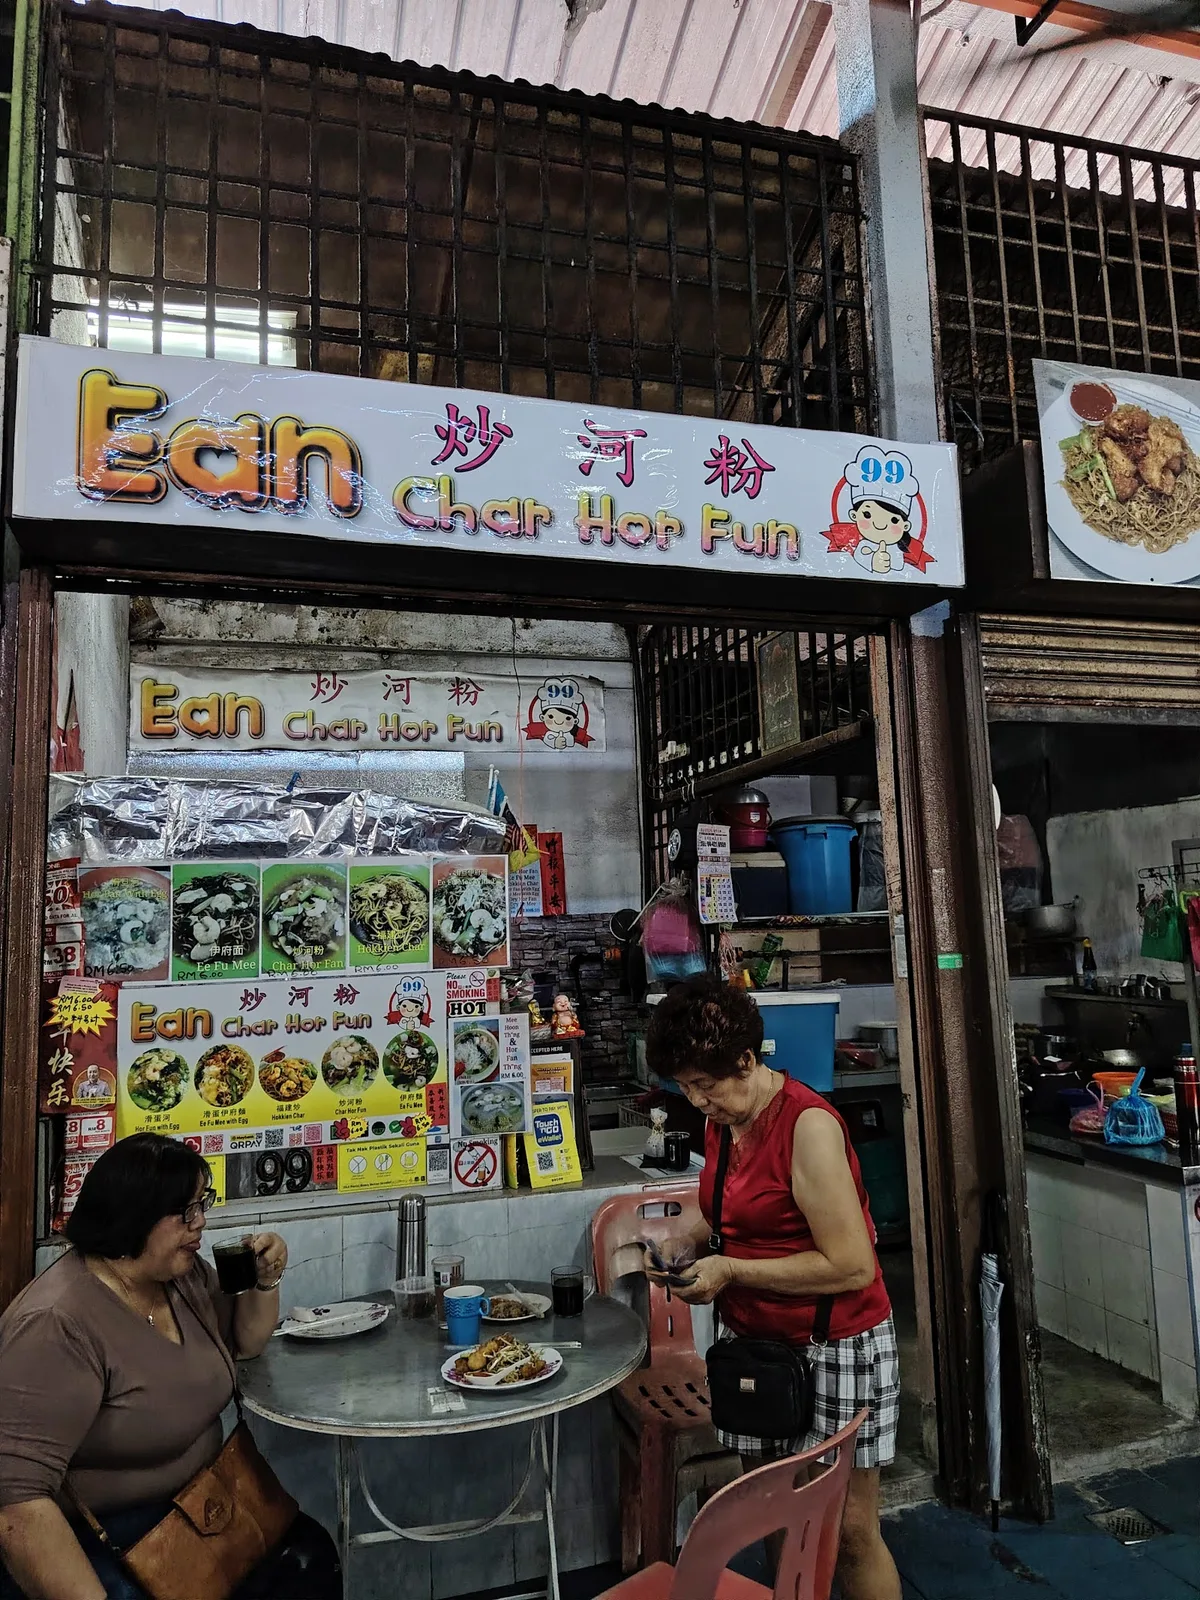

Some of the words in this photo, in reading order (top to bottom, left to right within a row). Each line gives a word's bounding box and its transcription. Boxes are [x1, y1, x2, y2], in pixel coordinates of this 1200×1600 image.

[77, 366, 363, 518] Ean
[431, 402, 776, 499] 炒河粉
[860, 456, 905, 485] 99
[392, 473, 551, 541] Char
[576, 490, 687, 552] Hor
[700, 502, 801, 561] Fun
[310, 671, 485, 706] 炒河粉
[547, 684, 574, 699] 99
[141, 678, 266, 739] Ean
[283, 709, 368, 741] Char
[377, 712, 438, 742] Hor
[446, 713, 503, 743] Fun
[209, 944, 244, 957] 伊府面
[357, 944, 399, 954] Hokkien
[403, 942, 425, 952] Char
[196, 961, 211, 971] Ee
[214, 961, 229, 971] Fu
[232, 960, 256, 970] Mee
[272, 961, 298, 971] Char
[300, 961, 322, 970] Hor
[324, 959, 344, 969] Fan
[446, 972, 467, 980] Please
[402, 981, 422, 993] 99
[446, 980, 458, 990] NO
[238, 983, 361, 1012] 炒河粉
[446, 988, 486, 999] SMOKING
[449, 1001, 487, 1016] HOT
[131, 1001, 213, 1044] Ean
[220, 1015, 279, 1038] Char
[284, 1013, 327, 1034] Hor
[332, 1010, 372, 1031] Fun
[509, 1038, 517, 1046] &
[169, 1123, 180, 1131] Egg
[238, 1117, 249, 1125] Egg
[534, 1118, 559, 1129] Touch
[230, 1139, 262, 1149] QRPAY
[457, 1140, 468, 1148] No
[468, 1137, 498, 1146] Smoking
[537, 1133, 562, 1144] eWallet
[256, 1148, 314, 1196] 99
